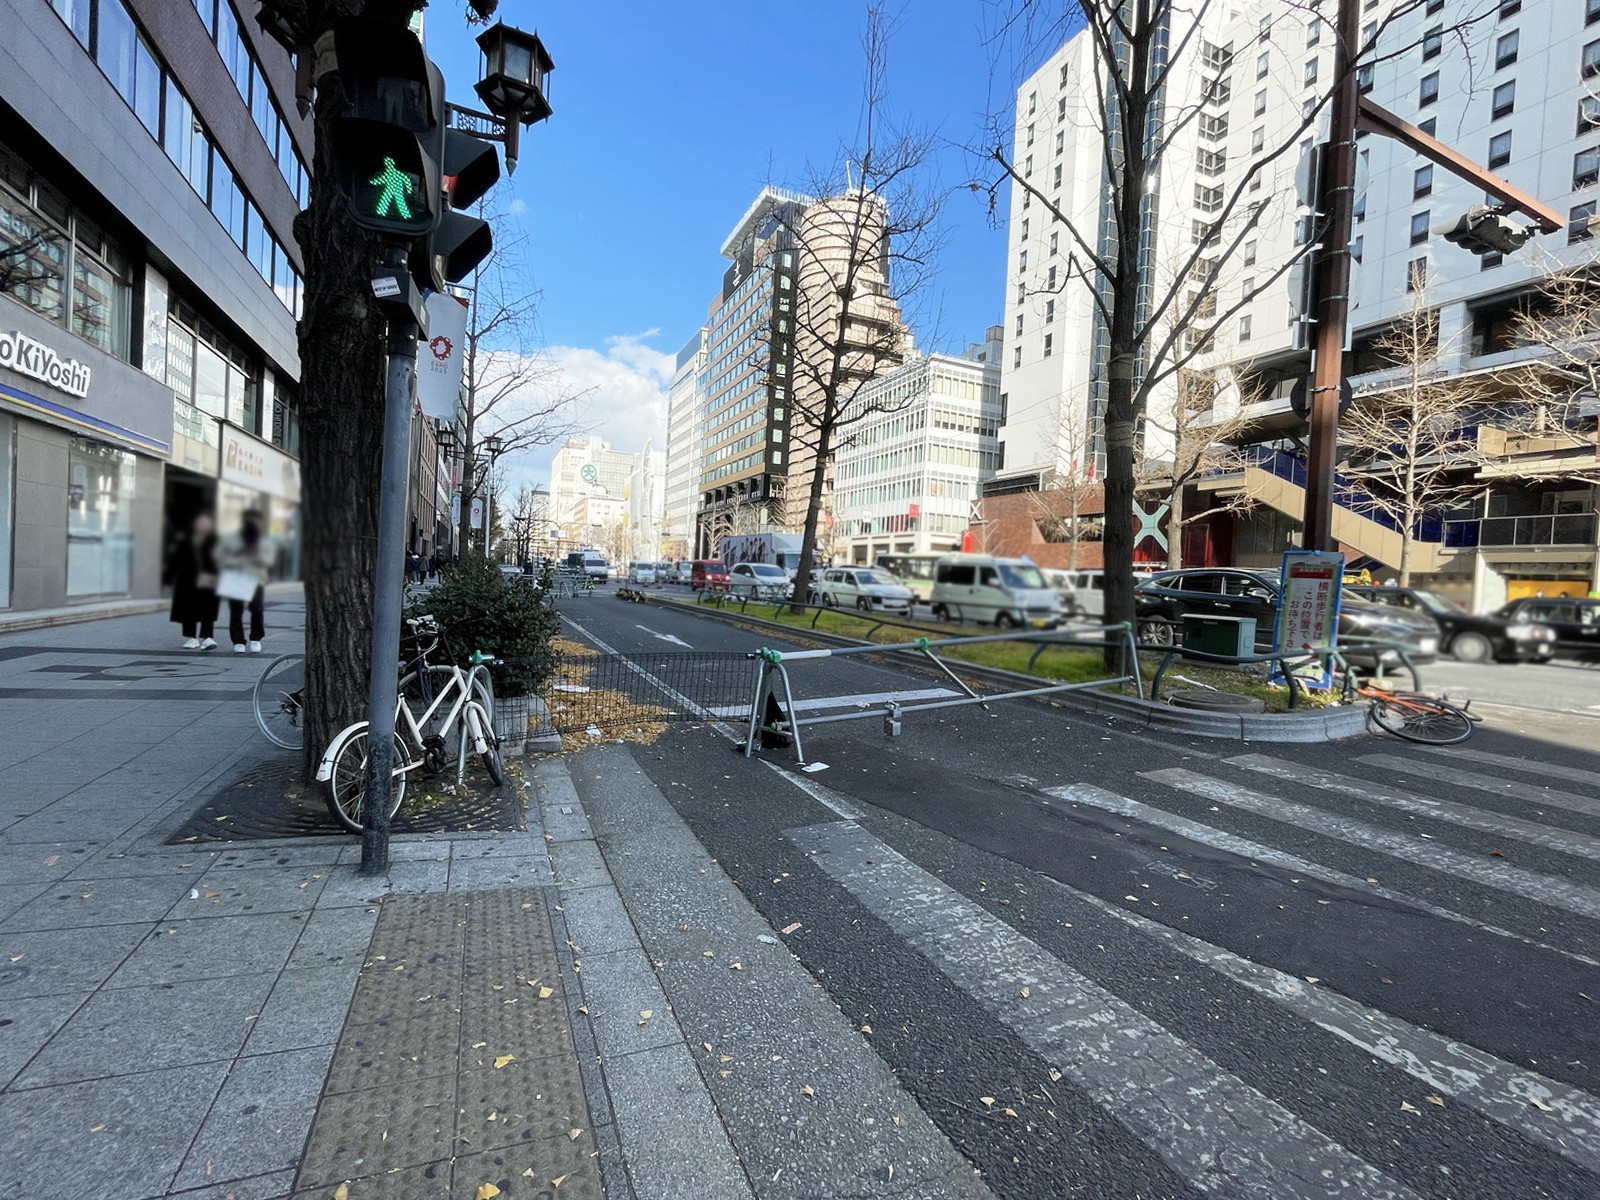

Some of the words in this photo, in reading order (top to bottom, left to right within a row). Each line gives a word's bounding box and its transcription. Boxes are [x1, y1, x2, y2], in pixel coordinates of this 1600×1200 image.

[1300, 591, 1312, 639] この位置で
[1313, 582, 1329, 640] 横断歩行者は
